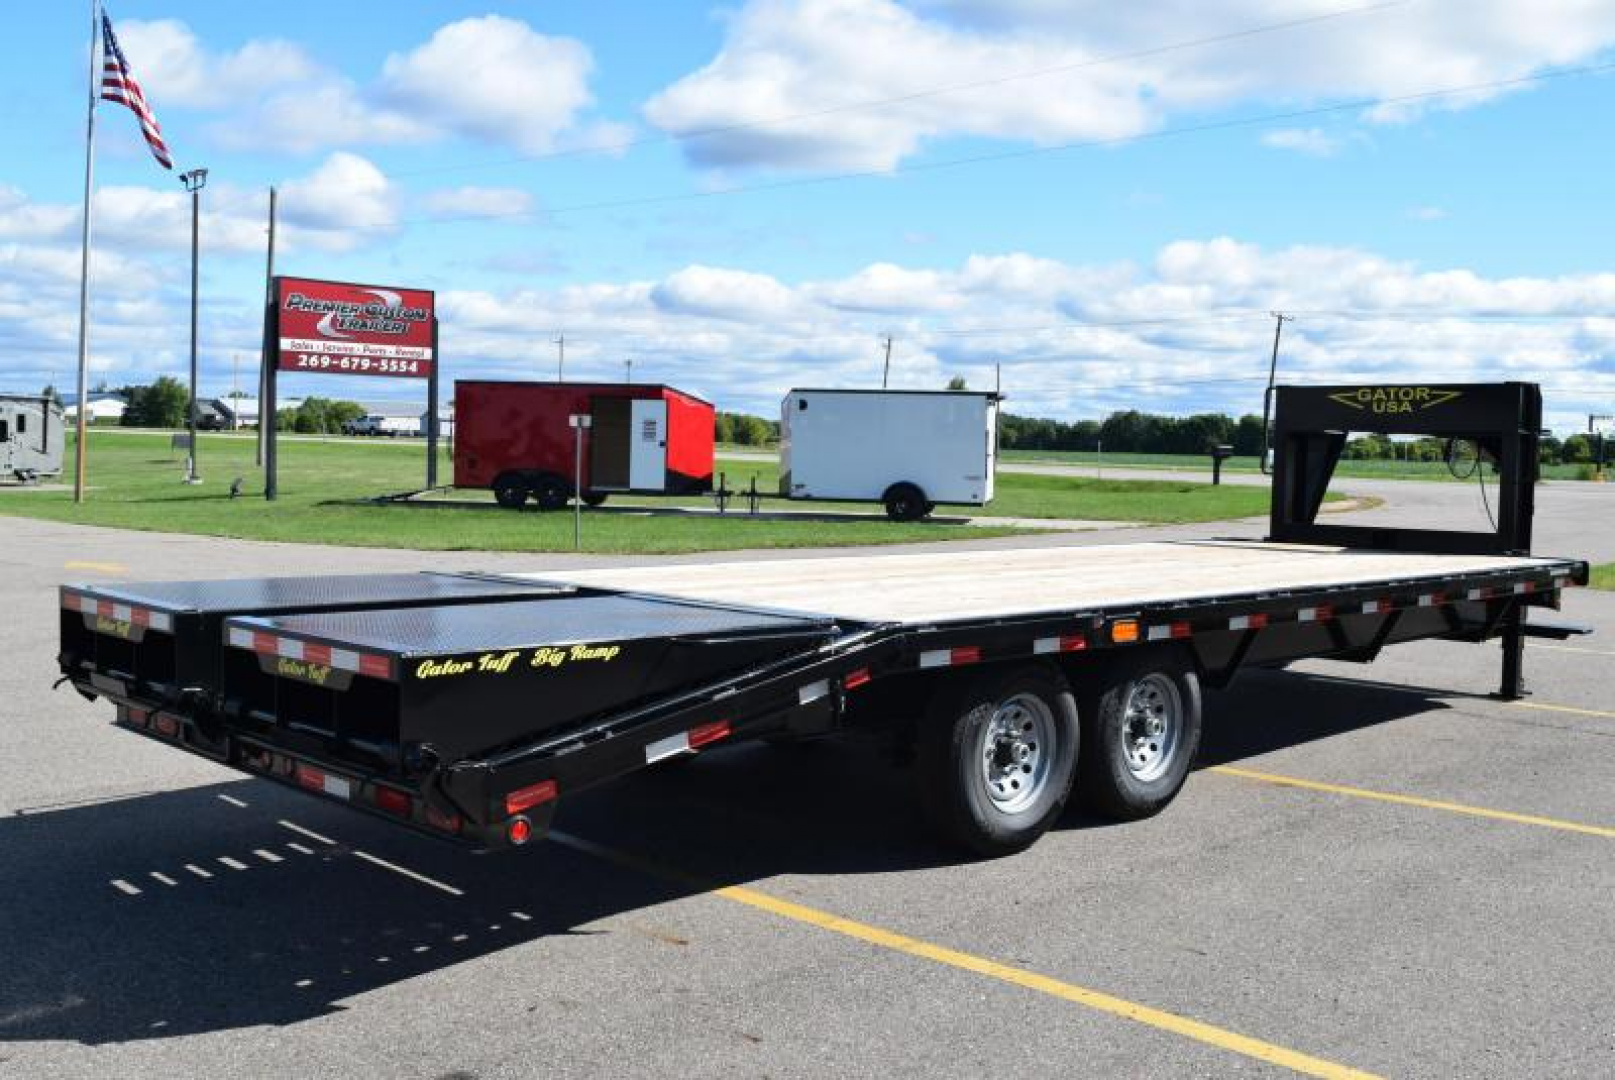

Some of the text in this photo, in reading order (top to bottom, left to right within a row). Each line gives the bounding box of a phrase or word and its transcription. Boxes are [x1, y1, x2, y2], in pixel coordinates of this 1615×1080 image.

[298, 354, 419, 373] 269-679-5554
[1357, 387, 1430, 401] GATOR
[1372, 399, 1412, 413] USA
[416, 644, 620, 679] Gator Tuff Big Ramp
